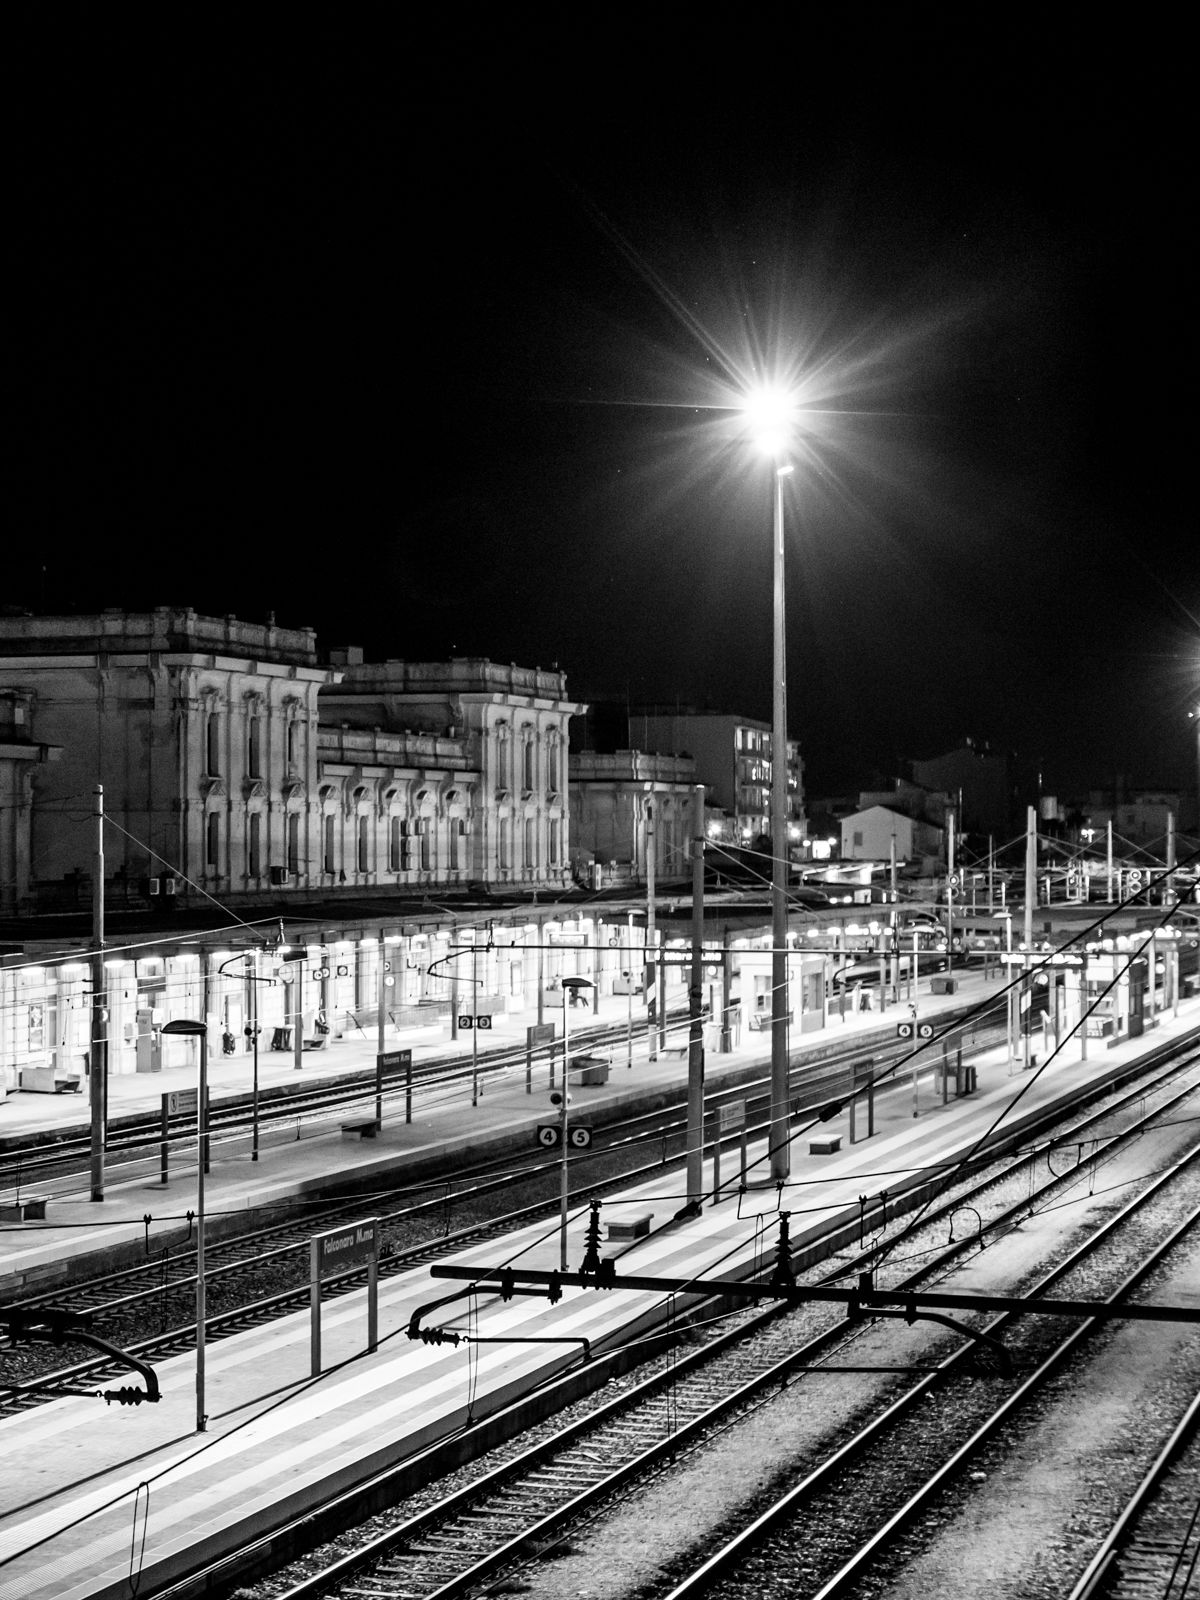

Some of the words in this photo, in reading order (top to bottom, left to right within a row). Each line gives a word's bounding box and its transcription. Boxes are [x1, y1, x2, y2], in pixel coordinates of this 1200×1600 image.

[543, 1130, 553, 1142] 4
[576, 1131, 586, 1143] 5
[323, 1234, 354, 1255] Falconara
[356, 1228, 374, 1244] M.ma
